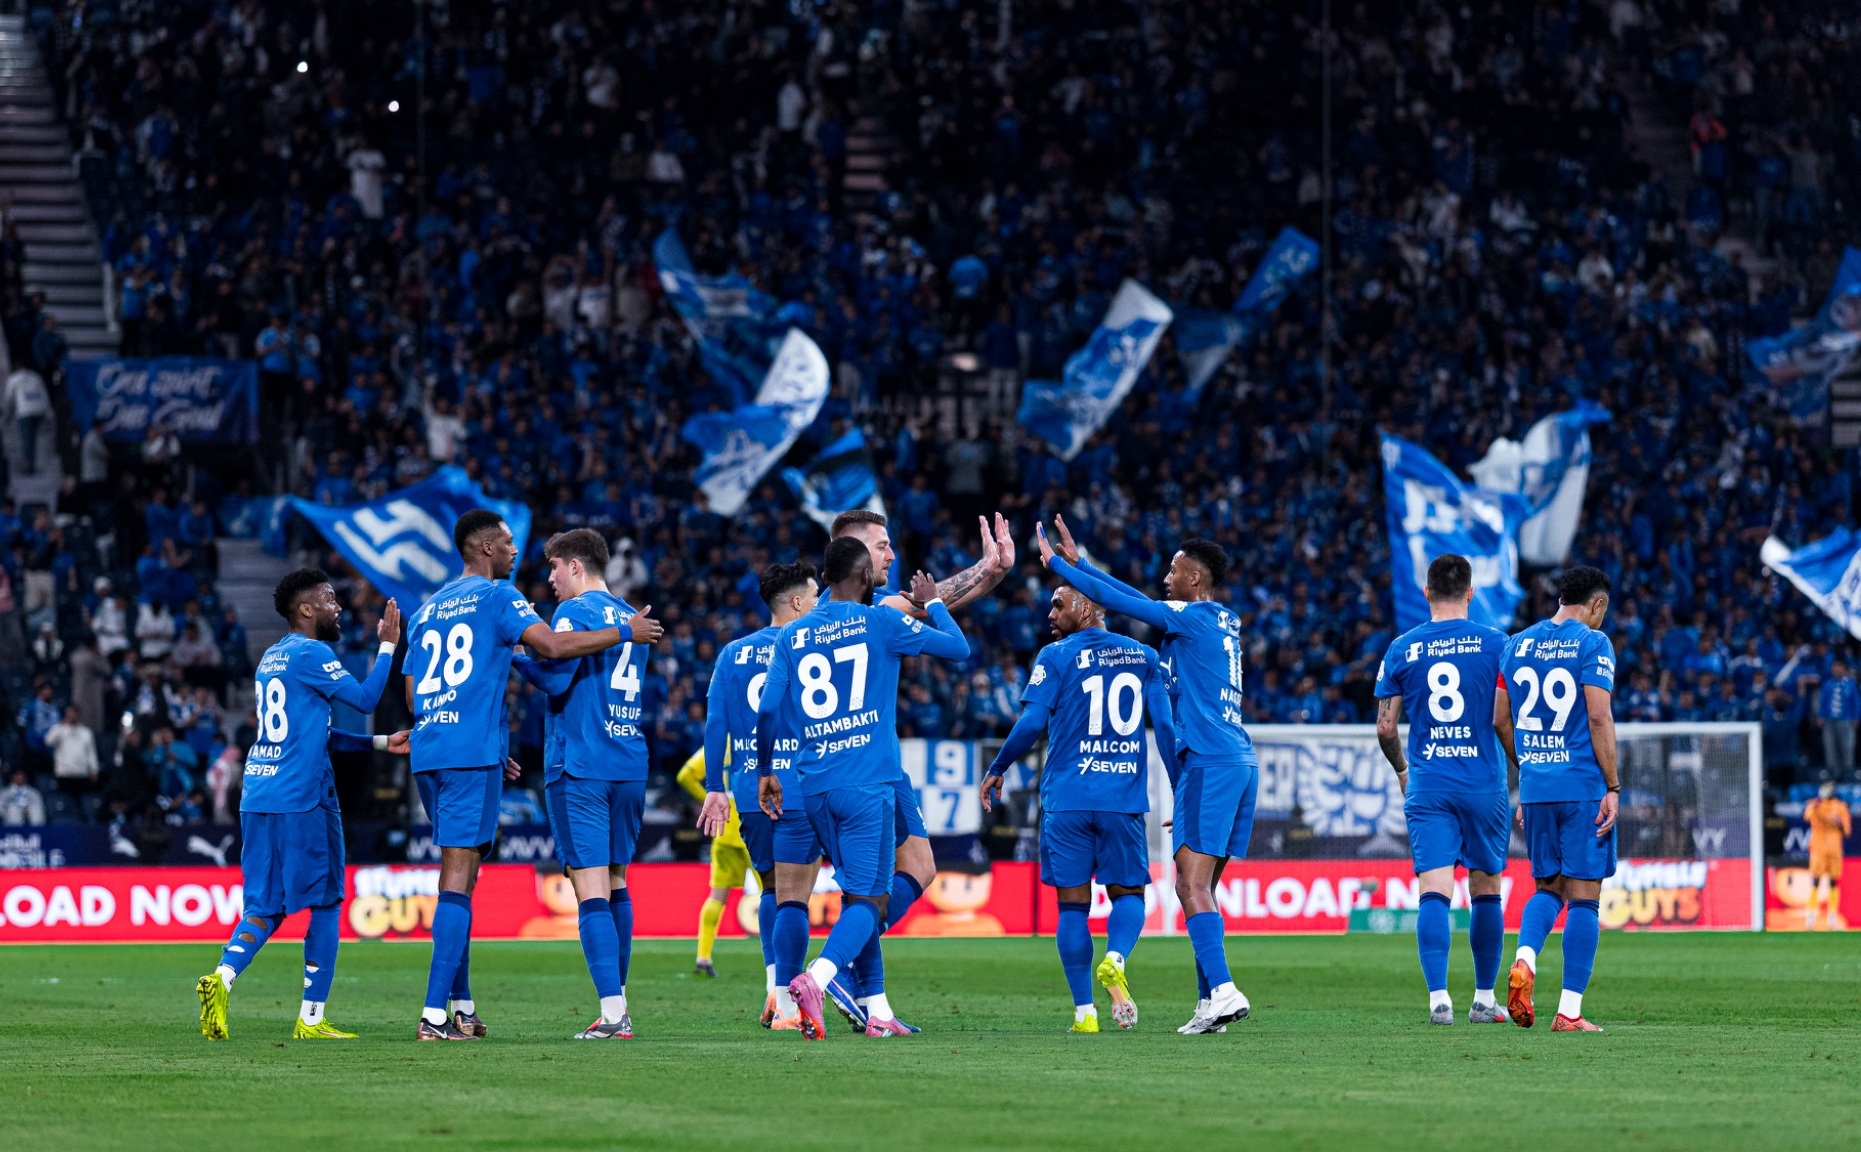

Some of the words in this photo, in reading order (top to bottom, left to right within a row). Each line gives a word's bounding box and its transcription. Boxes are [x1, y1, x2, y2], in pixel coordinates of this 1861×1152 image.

[459, 604, 477, 615] Bank
[815, 632, 843, 645] Riyad
[843, 625, 867, 638] Bank
[416, 623, 473, 695] 28
[1427, 647, 1456, 657] Riyad
[1457, 644, 1482, 654] Bank
[1534, 650, 1556, 661] Riyad
[1557, 649, 1578, 658] Bank
[1098, 656, 1125, 667] Riyad
[1125, 655, 1147, 665] Bank
[611, 641, 640, 702] 4
[797, 642, 869, 719] 87
[1427, 661, 1465, 723] 8
[1513, 666, 1577, 732] 29
[608, 703, 642, 721] YUSUF
[1081, 672, 1143, 736] 10
[804, 709, 879, 739] ALTAMBAKTI
[1430, 726, 1471, 739] NEVES
[828, 733, 871, 753] SEVEN
[1079, 740, 1140, 754] MALCOM
[1523, 734, 1565, 748] SALEM
[1436, 746, 1478, 758] SEVEN
[1530, 750, 1570, 764] SEVEN
[1090, 760, 1137, 774] SEVEN
[941, 791, 961, 829] 7
[0, 885, 117, 928] OAD
[1600, 886, 1701, 929] GUYS
